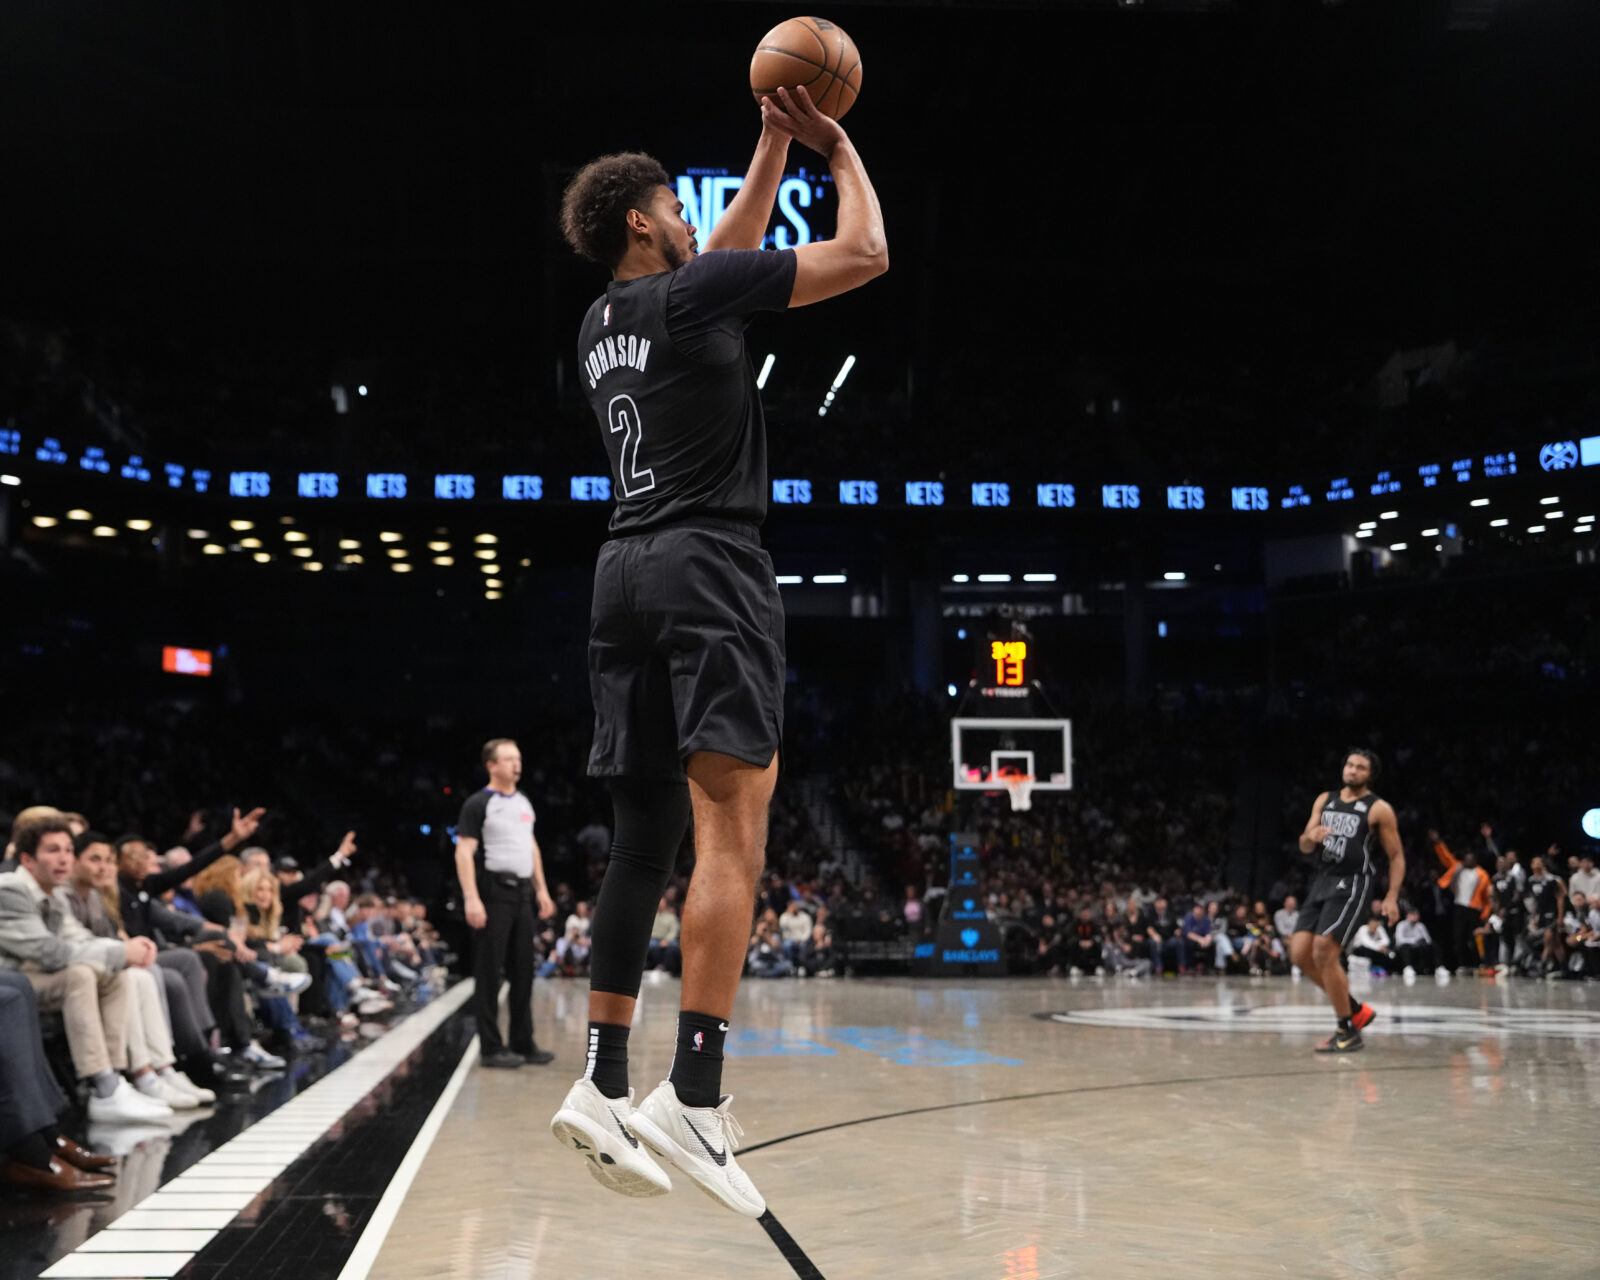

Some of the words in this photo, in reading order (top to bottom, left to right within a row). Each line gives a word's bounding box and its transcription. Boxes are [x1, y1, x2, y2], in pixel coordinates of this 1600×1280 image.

[677, 175, 811, 252] NES
[584, 334, 651, 389] JOHNSON
[608, 393, 655, 498] 2
[229, 472, 270, 497] NETS
[298, 472, 339, 498] NETS
[366, 473, 407, 498] NETS
[435, 474, 475, 499] NETS
[502, 475, 543, 500] NETS
[571, 476, 611, 501] NETS
[773, 479, 812, 504] NETS
[839, 480, 878, 505] NETS
[905, 481, 944, 505] NETS
[972, 483, 1010, 506] NETS
[1037, 483, 1075, 507] NETS
[1102, 485, 1140, 509] NETS
[1167, 486, 1205, 510] NETS
[1232, 487, 1269, 510] NETS
[996, 657, 1024, 686] 13
[1321, 811, 1361, 839] NETS
